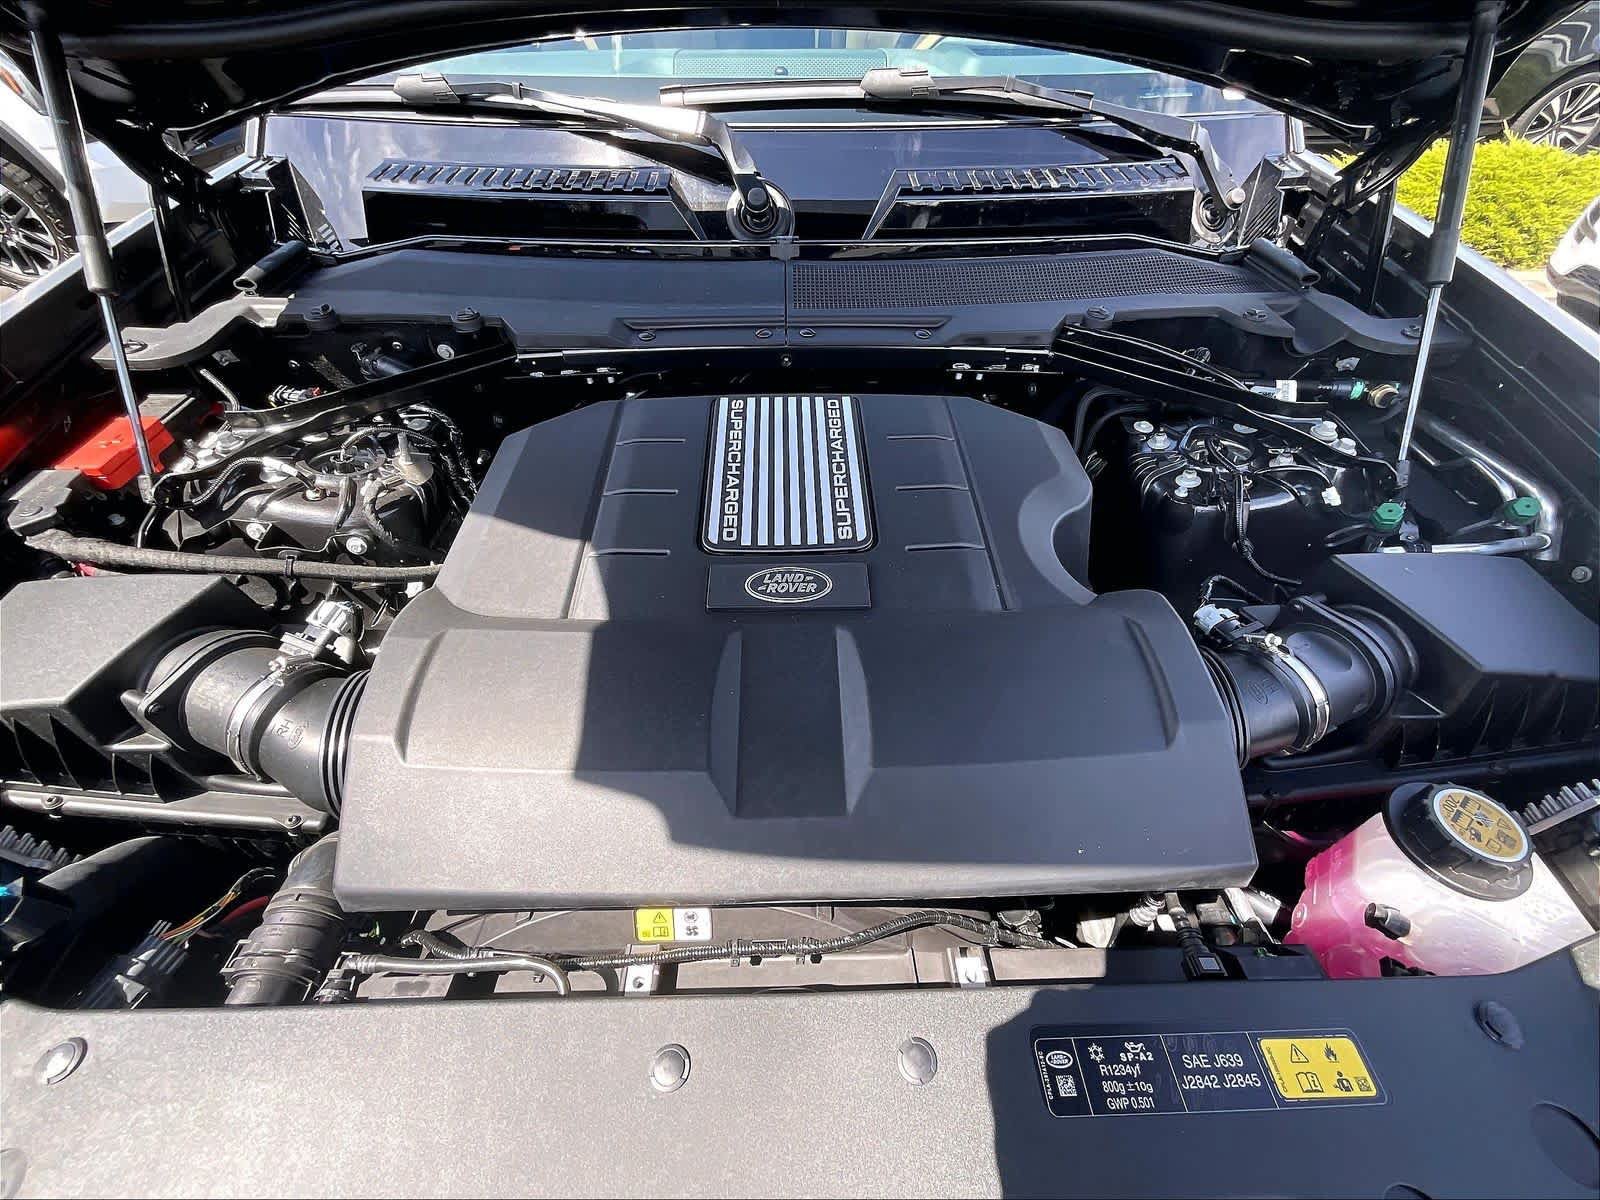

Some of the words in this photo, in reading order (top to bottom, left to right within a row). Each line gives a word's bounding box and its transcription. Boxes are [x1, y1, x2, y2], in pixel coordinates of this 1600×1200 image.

[723, 399, 744, 542] SUPERCHARGED
[827, 399, 852, 540] SUPERCHARGED
[276, 718, 294, 737] RH
[1119, 1052, 1154, 1062] SP-A2
[1183, 1054, 1211, 1069] SAE
[1213, 1053, 1244, 1068] J639
[1099, 1063, 1141, 1078] R1234yf
[1102, 1081, 1125, 1095] 800g
[1127, 1080, 1154, 1093] ±10g
[1181, 1074, 1220, 1089] J2842
[1222, 1073, 1261, 1088] J2845
[1106, 1097, 1130, 1110] GWP
[1130, 1097, 1155, 1109] 0.501
